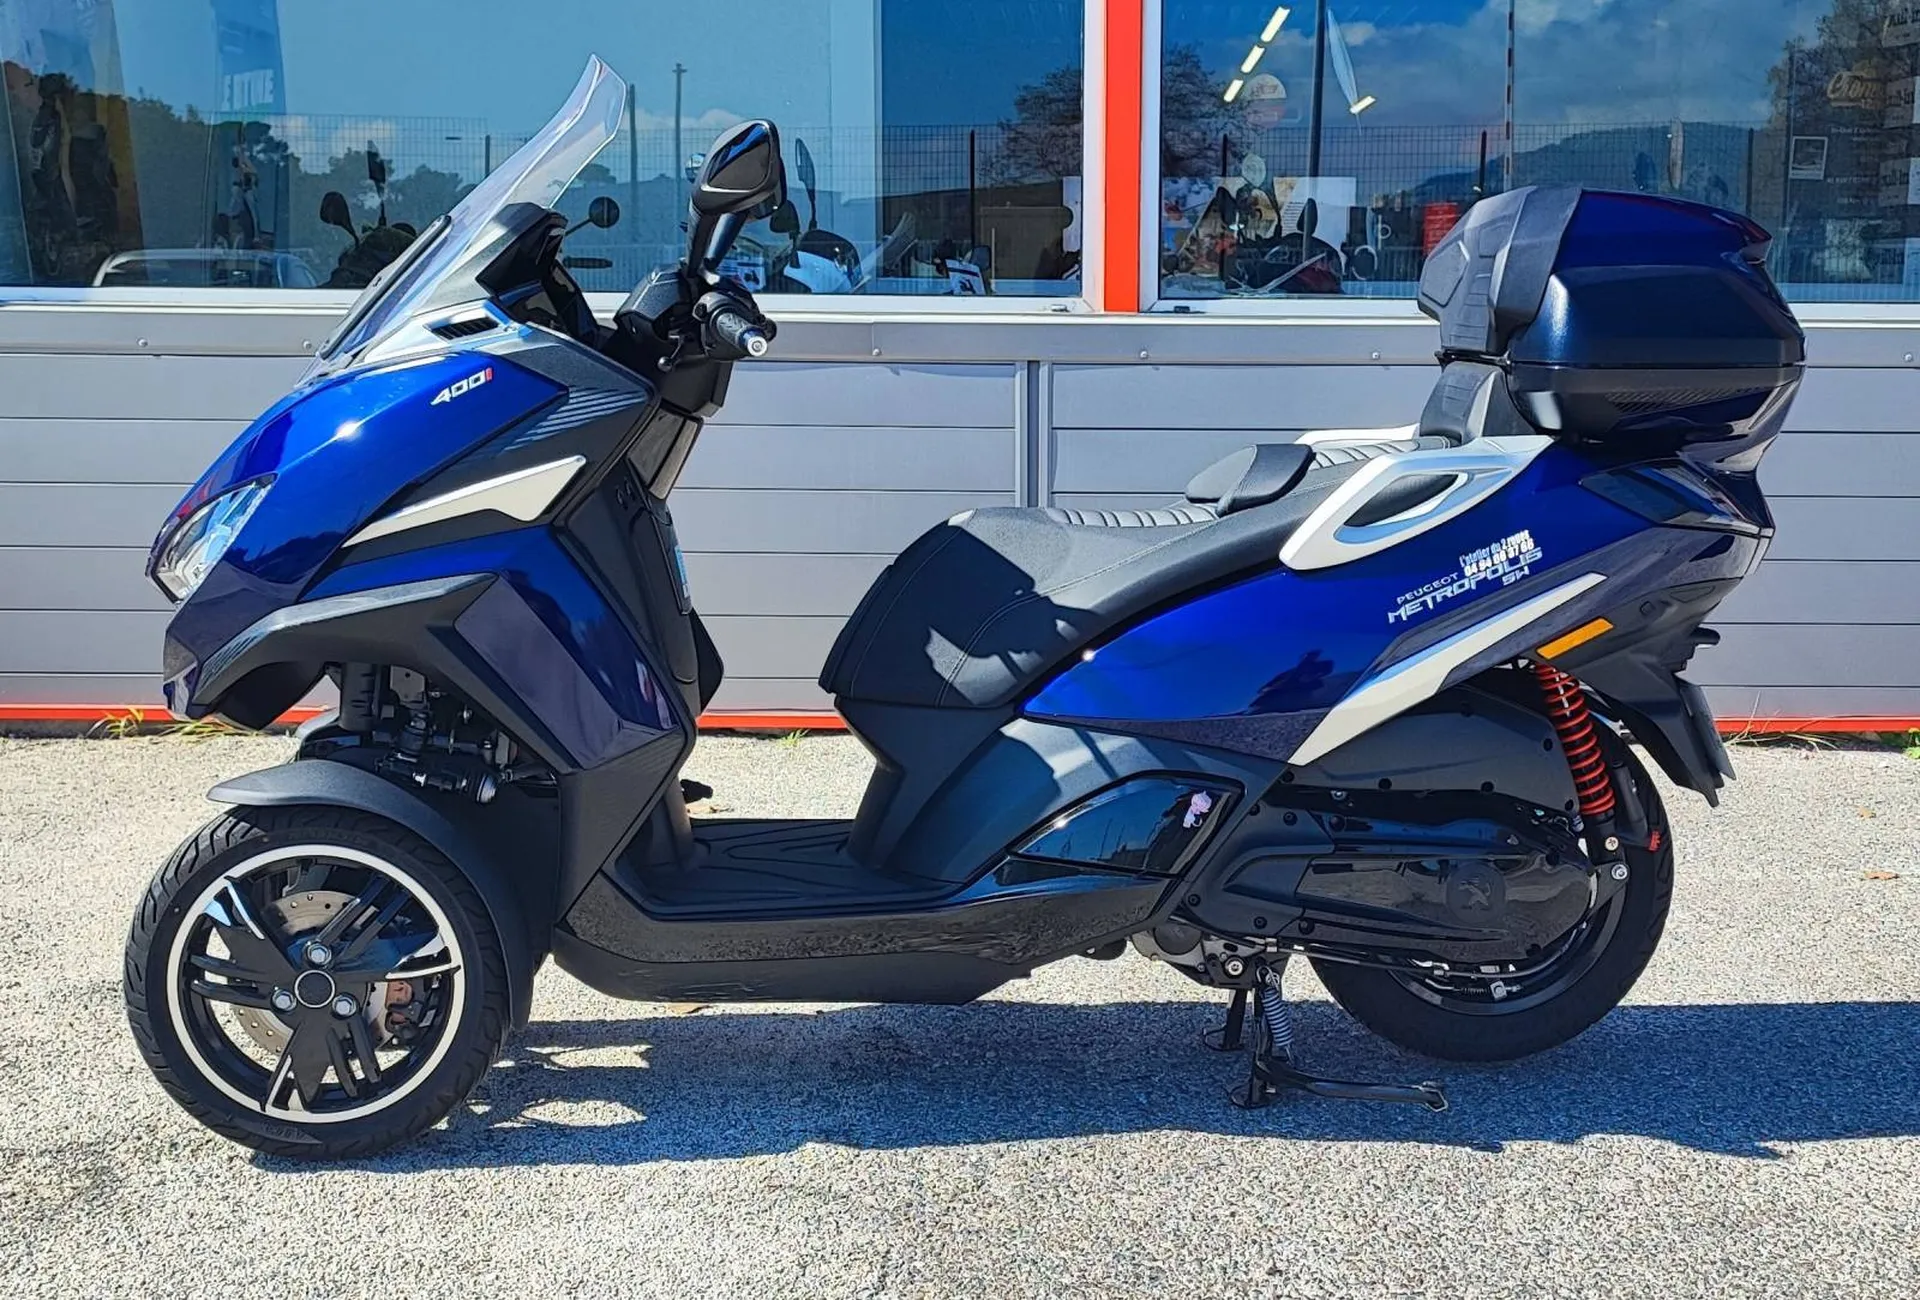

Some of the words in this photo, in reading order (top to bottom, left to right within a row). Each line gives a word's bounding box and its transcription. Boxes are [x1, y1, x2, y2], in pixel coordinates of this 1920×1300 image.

[1500, 538, 1507, 550] 2
[1464, 562, 1478, 577] 04
[1478, 556, 1493, 571] 94
[1502, 565, 1530, 586] SW
[1388, 547, 1543, 624] METROPOLIS
[1396, 572, 1458, 605] PEUGEOT
